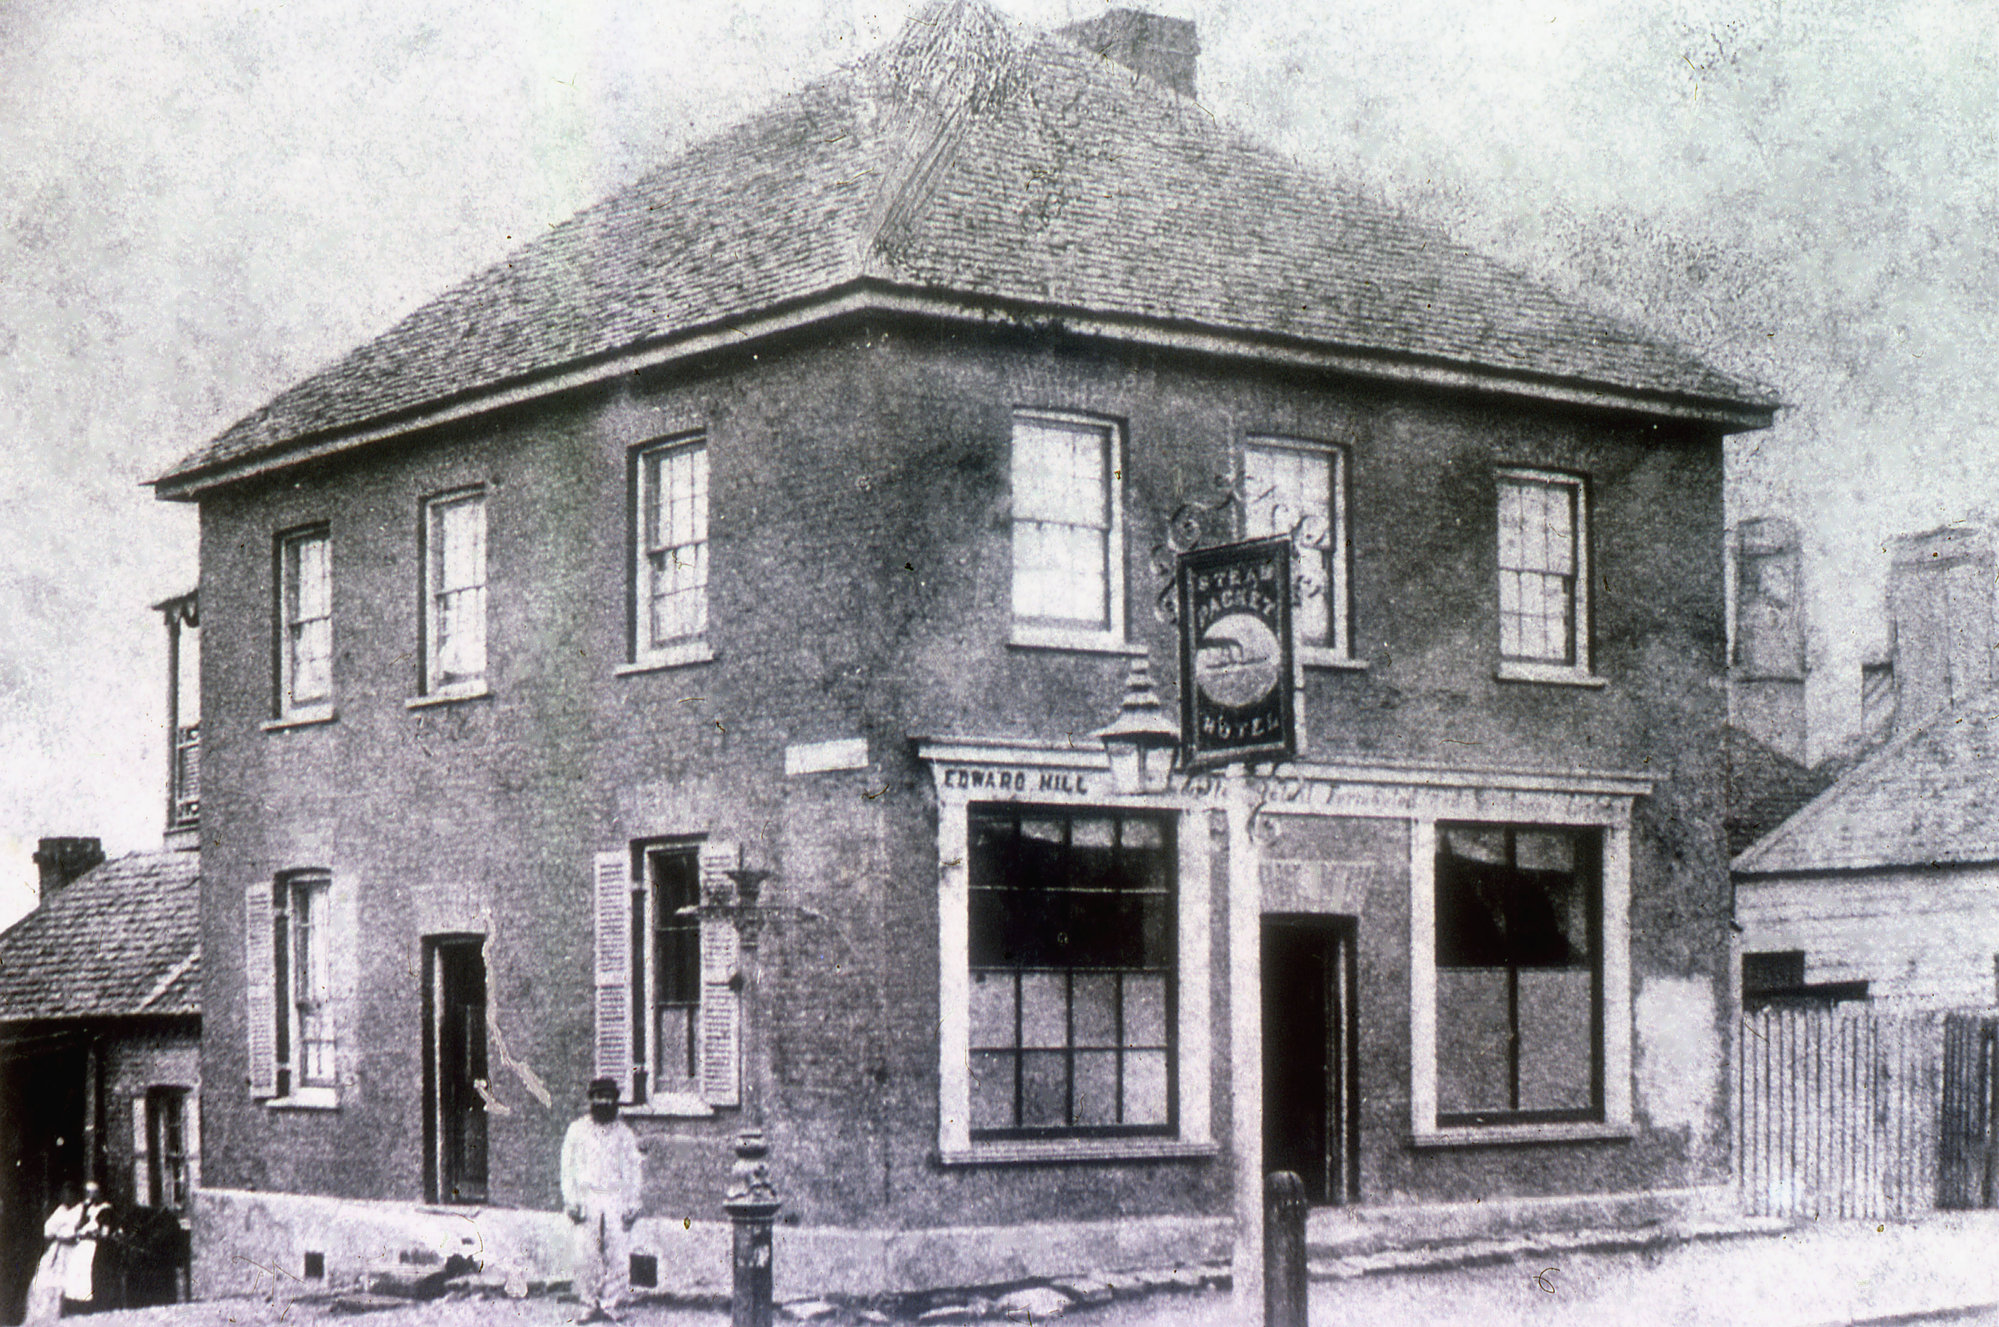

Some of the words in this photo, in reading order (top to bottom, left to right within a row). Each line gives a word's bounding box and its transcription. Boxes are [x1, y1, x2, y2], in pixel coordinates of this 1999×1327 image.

[1198, 564, 1274, 591] STEAM
[1198, 588, 1276, 628] PACKET
[1203, 713, 1280, 739] HOTEL
[944, 769, 1026, 792] EDWARD
[1039, 773, 1088, 795] HILL
